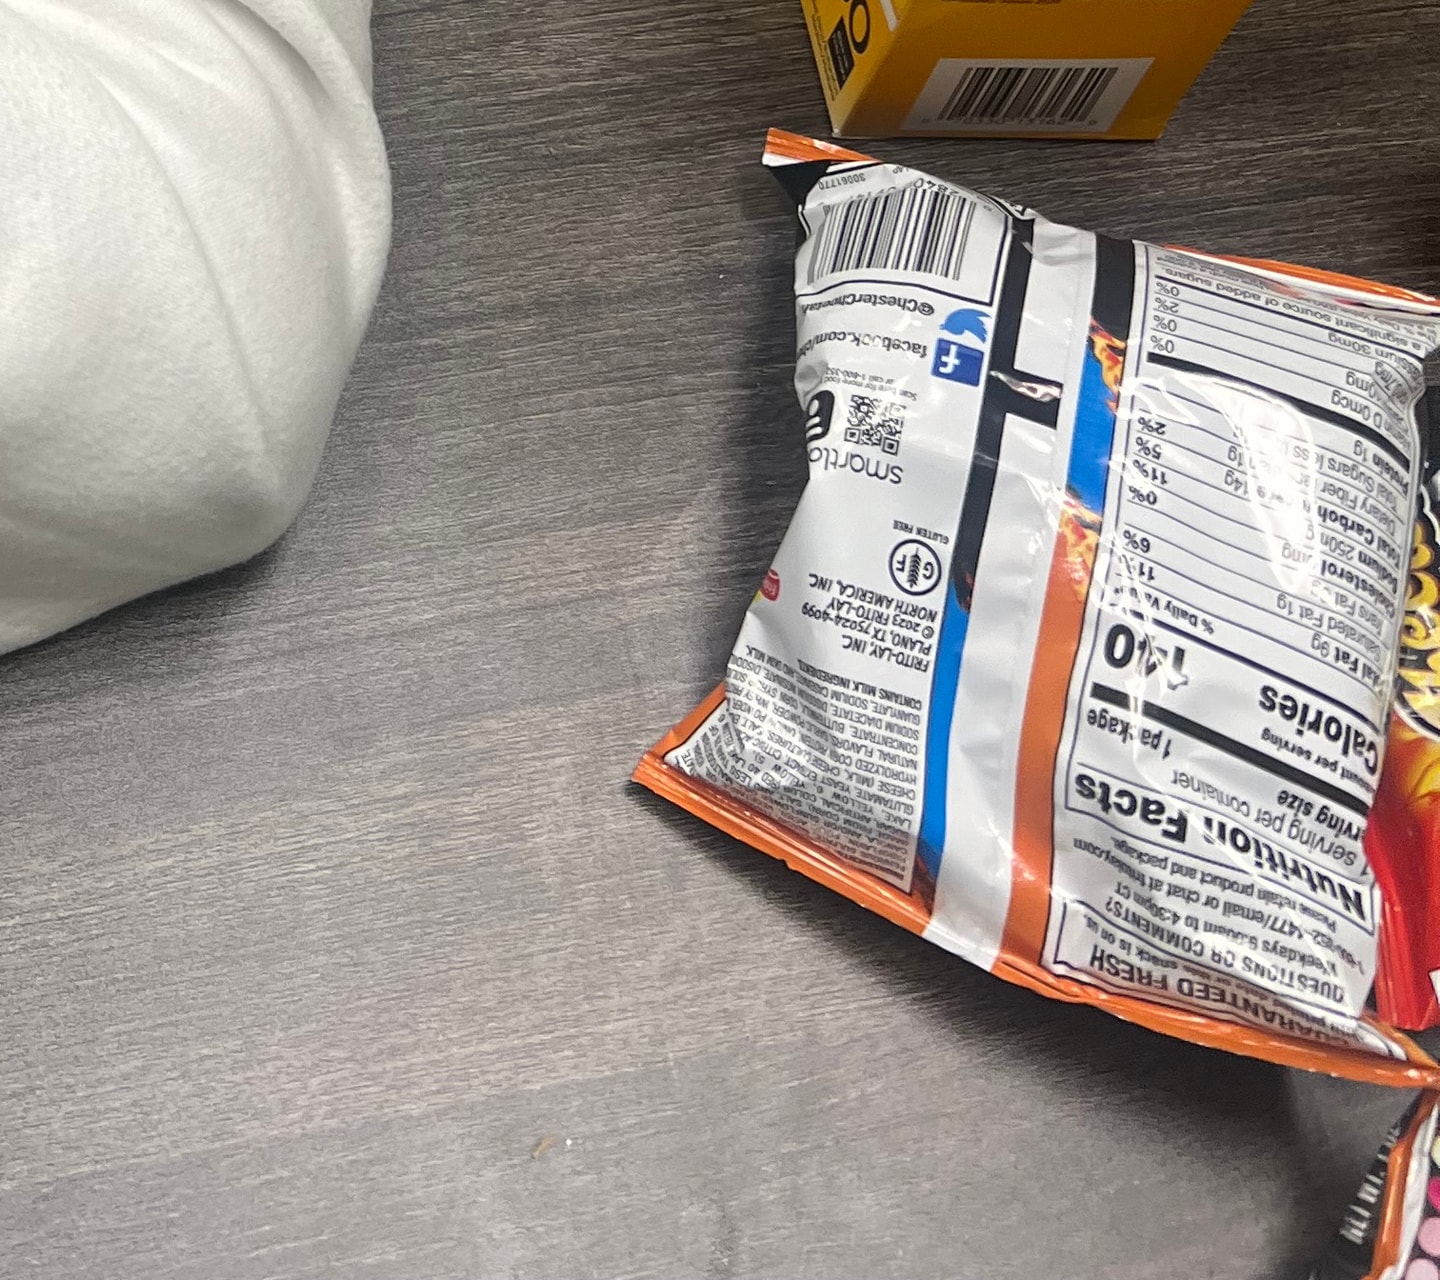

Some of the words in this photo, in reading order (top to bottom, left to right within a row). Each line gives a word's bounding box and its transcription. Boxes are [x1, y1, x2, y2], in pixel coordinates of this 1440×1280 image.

[1154, 281, 1179, 296] 0%
[1159, 265, 1211, 288] sugars.
[1153, 295, 1179, 312] 2%
[1214, 282, 1261, 304] added
[1264, 295, 1279, 307] of
[1151, 313, 1176, 331] 0%
[1282, 300, 1330, 324] source
[1149, 333, 1175, 353] 0%
[1326, 331, 1371, 358] 30mg
[1333, 317, 1407, 347] significant
[1330, 389, 1370, 423] 0mcg
[1137, 415, 1166, 435] 2%
[1134, 435, 1161, 460] 5%
[1352, 439, 1368, 464] 1g
[1132, 458, 1167, 485] 11%
[1326, 453, 1376, 491] Sugars
[1319, 475, 1359, 509] Fiber
[892, 519, 913, 534] FREE
[915, 527, 949, 544] GLUTEN
[1122, 529, 1150, 553] 6%
[835, 578, 893, 608] AMERICA,
[1275, 593, 1293, 616] 1g
[801, 602, 870, 635] 75024-4099
[826, 596, 889, 625] FRITO-LAY
[893, 597, 937, 621] NORTH
[1162, 598, 1198, 627] Daily
[1296, 605, 1322, 630] Fat
[870, 627, 885, 641] TX
[892, 613, 920, 631] 2023
[889, 629, 932, 655] PLANO,
[1310, 633, 1330, 661] 9g
[869, 641, 929, 672] FRITO-LAY,
[1333, 646, 1358, 671] Fat
[830, 687, 868, 710] SODIUM
[852, 680, 876, 698] MILK
[878, 687, 921, 710] CONTAINS
[848, 725, 917, 754] CONCENTRATE,
[884, 720, 918, 740] SODIUM
[1259, 684, 1379, 776] Calories
[876, 748, 917, 769] NATURAL
[1260, 728, 1312, 764] serving
[854, 758, 916, 784] HYDROLYZED
[1313, 752, 1337, 771] per
[820, 774, 850, 797] YEAST
[876, 780, 916, 800] CHEESE
[1170, 768, 1250, 818] container
[831, 791, 874, 816] YELLOW
[1074, 772, 1187, 843] Facts
[1276, 789, 1312, 820] size
[1254, 809, 1283, 834] per
[1287, 818, 1356, 867] serving
[1169, 861, 1195, 881] and
[1202, 815, 1366, 921] Nutrition
[1148, 876, 1162, 890] at
[1166, 881, 1200, 905] chat
[1198, 866, 1253, 898] product
[1132, 890, 1180, 927] 4:30pm
[1203, 895, 1219, 909] or
[1104, 895, 1204, 962] COMMENTS?
[1184, 913, 1198, 930] to
[1088, 943, 1168, 990] FRESH
[1261, 938, 1337, 977] Weekdays
[1240, 954, 1343, 1005] QUESTIONS
